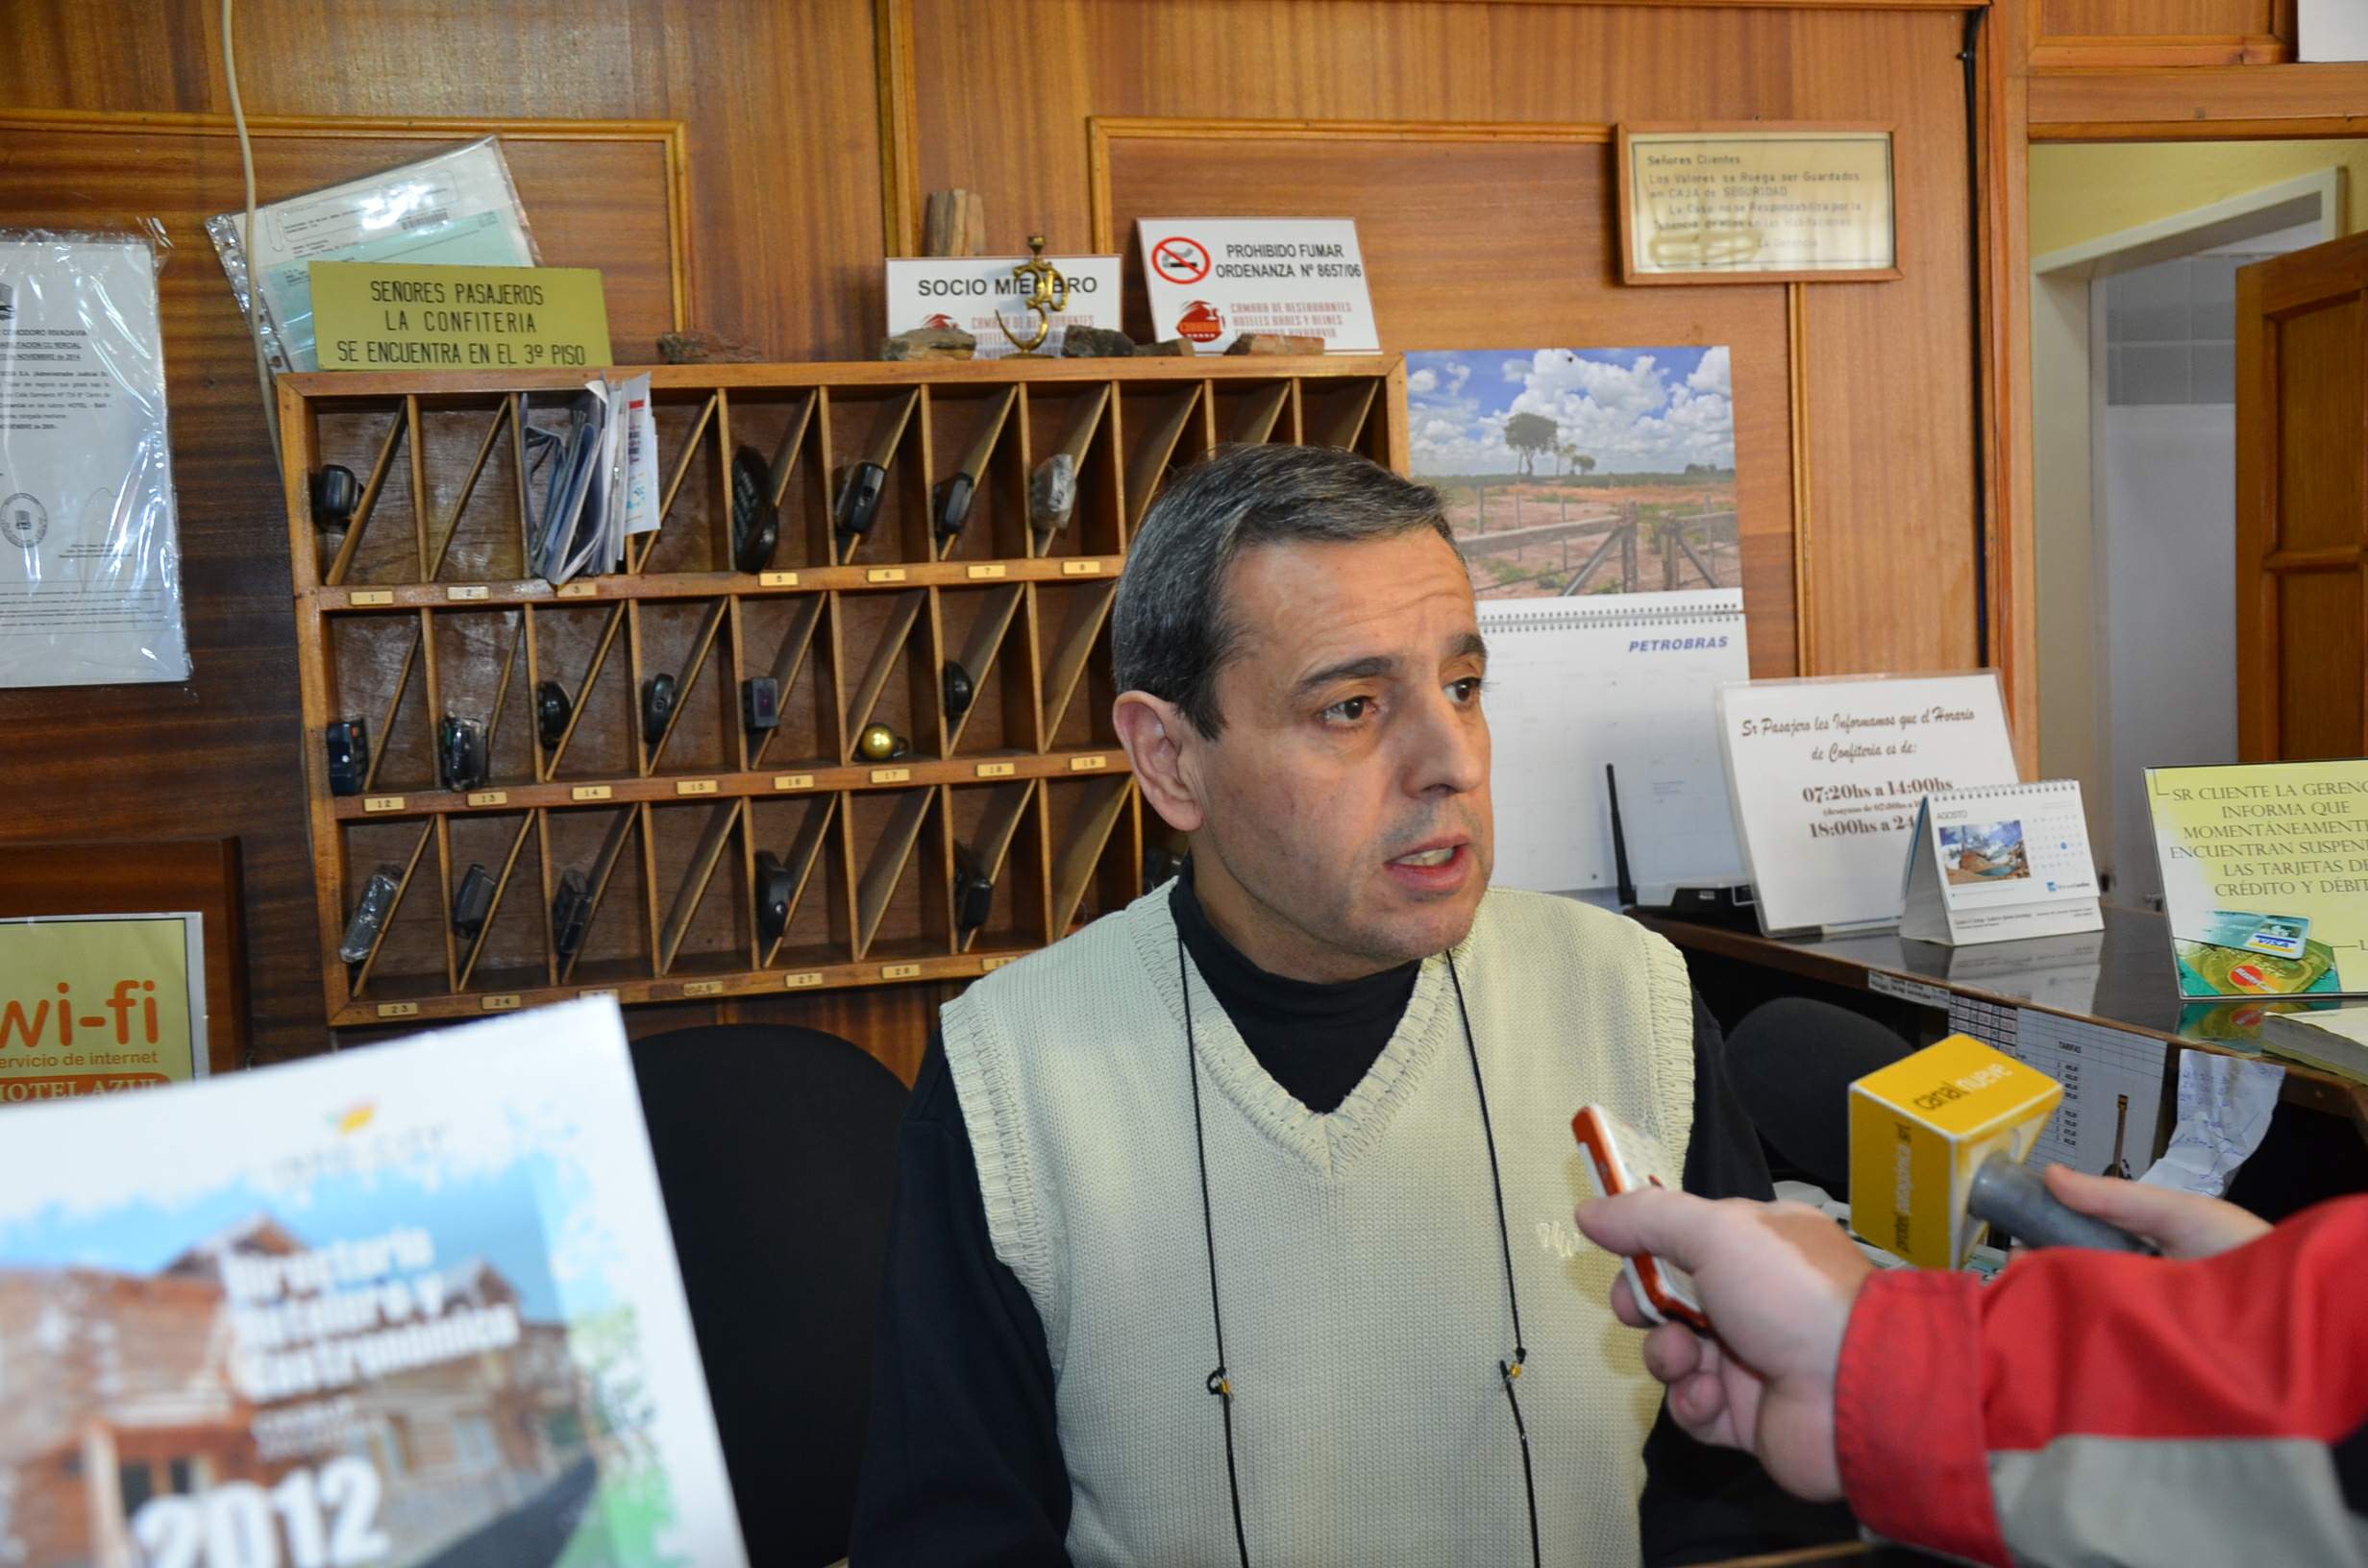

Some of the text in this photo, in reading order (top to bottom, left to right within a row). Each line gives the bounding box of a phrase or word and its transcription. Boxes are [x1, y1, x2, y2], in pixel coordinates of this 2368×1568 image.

[1226, 243, 1344, 258] PROHIBIDO FUMAR
[1216, 263, 1295, 279] ORDENANZA
[1318, 262, 1362, 279] 8657/06
[371, 280, 544, 306] SEÑORES PASAJEROS
[918, 277, 1098, 296] SOCIO MIEBRO
[384, 310, 536, 333] LA CONFITERIA
[337, 340, 358, 362] SE
[367, 341, 461, 364] ENCUENTRA
[469, 343, 490, 364] EN
[498, 343, 518, 364] EL
[552, 345, 585, 366] PISO
[1629, 636, 1729, 652] PETROBRAS
[1741, 706, 1975, 737] Sr Pasajero les Informamos que el Horario
[1812, 747, 1823, 761] de
[1829, 743, 1882, 763] Confiteria
[1886, 745, 1897, 756] es
[1802, 777, 1953, 803] 07:20hs a 14:00hs
[2173, 789, 2193, 801] SR
[2199, 785, 2269, 800] CLIENTE
[2276, 784, 2298, 797] LA
[2222, 801, 2352, 819] INFORMA QUE
[1810, 820, 1877, 838] 18:00hs
[1881, 821, 1890, 831] a
[2170, 842, 2295, 859] ENCUENTRAN
[2224, 863, 2253, 877] LAS
[2260, 860, 2344, 877] TARJETAS
[2214, 878, 2296, 896] CRÉDITO
[2298, 880, 2313, 894] Y
[2257, 938, 2291, 948] VISA
[391, 1004, 407, 1014] 23
[494, 997, 510, 1007] 24
[0, 980, 159, 1049] wi-fi
[0, 1050, 159, 1068] ervicio de internet
[132, 1455, 388, 1568] 2012
